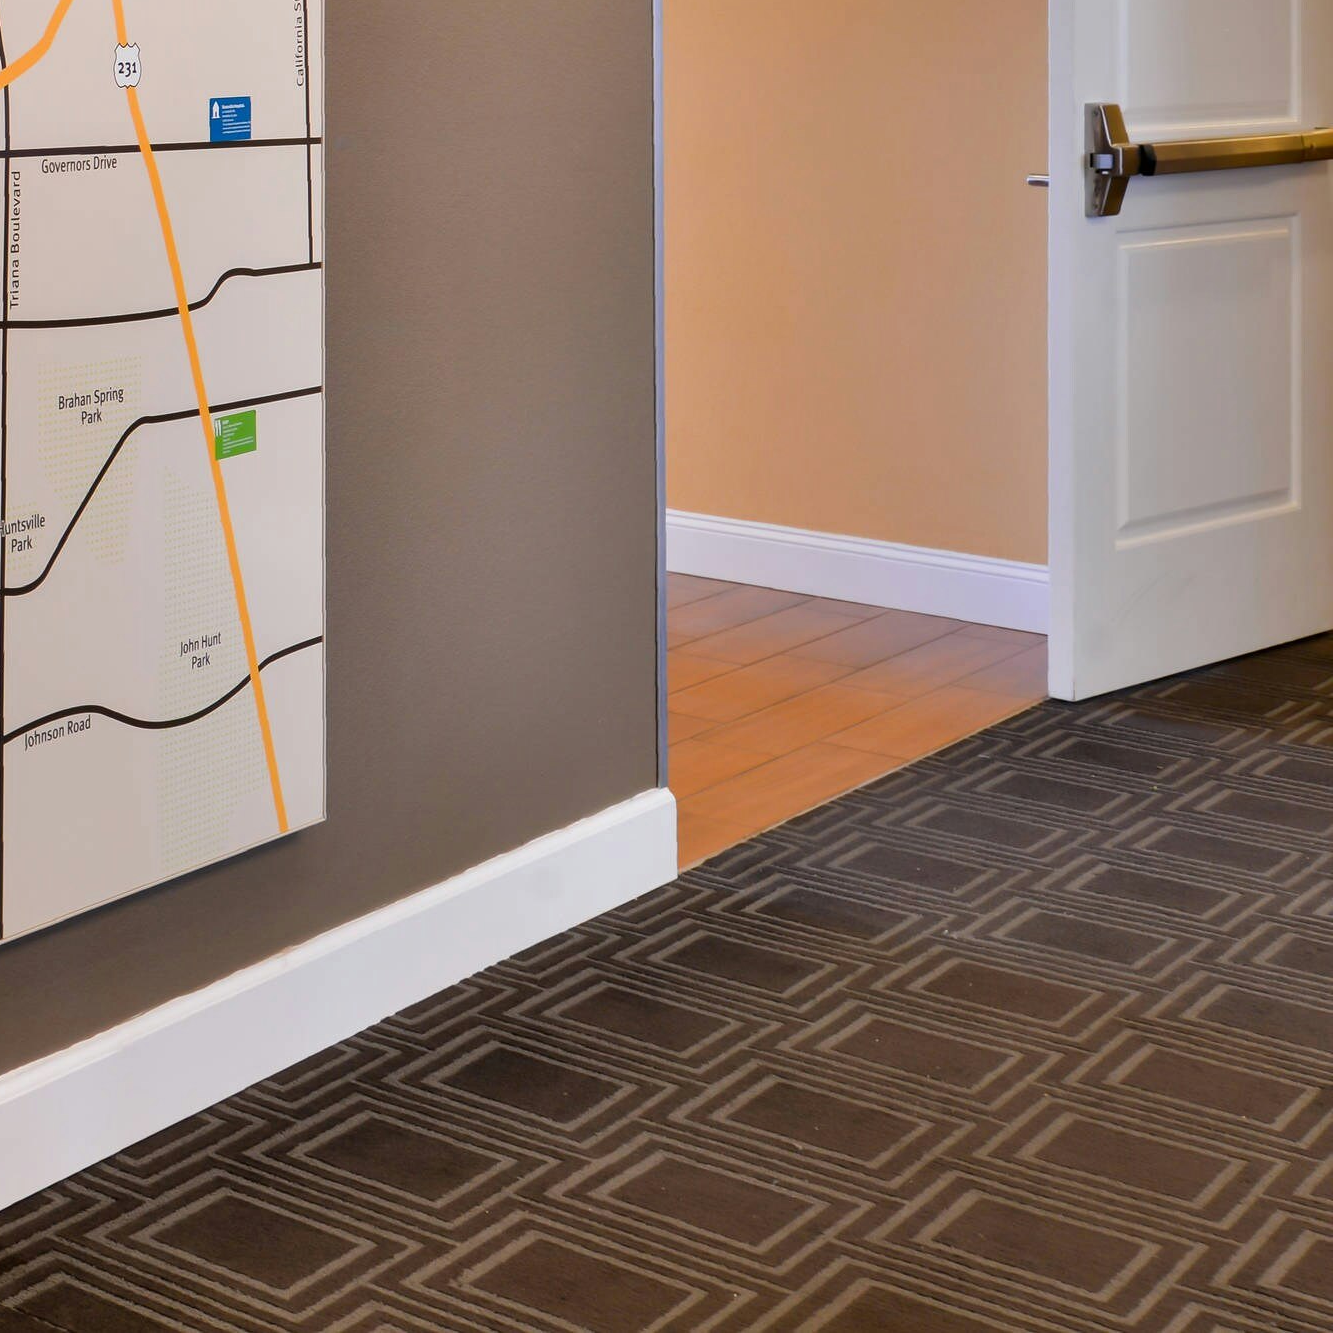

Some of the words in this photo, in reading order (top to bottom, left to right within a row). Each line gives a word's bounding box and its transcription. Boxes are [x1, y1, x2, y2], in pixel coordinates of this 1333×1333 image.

[296, 16, 305, 87] California
[117, 60, 138, 77] 231
[40, 156, 91, 175] Governors
[93, 154, 118, 172] Drive
[10, 170, 21, 254] Boulevard
[10, 256, 20, 310] Triana
[58, 392, 92, 411] Brahan
[94, 387, 124, 405] Spring
[81, 409, 102, 426] Park
[10, 536, 33, 553] Park
[180, 638, 198, 657] John
[201, 632, 221, 651] Hunt
[191, 652, 210, 670] Park
[24, 726, 64, 752] Johnson
[67, 715, 91, 736] Road
